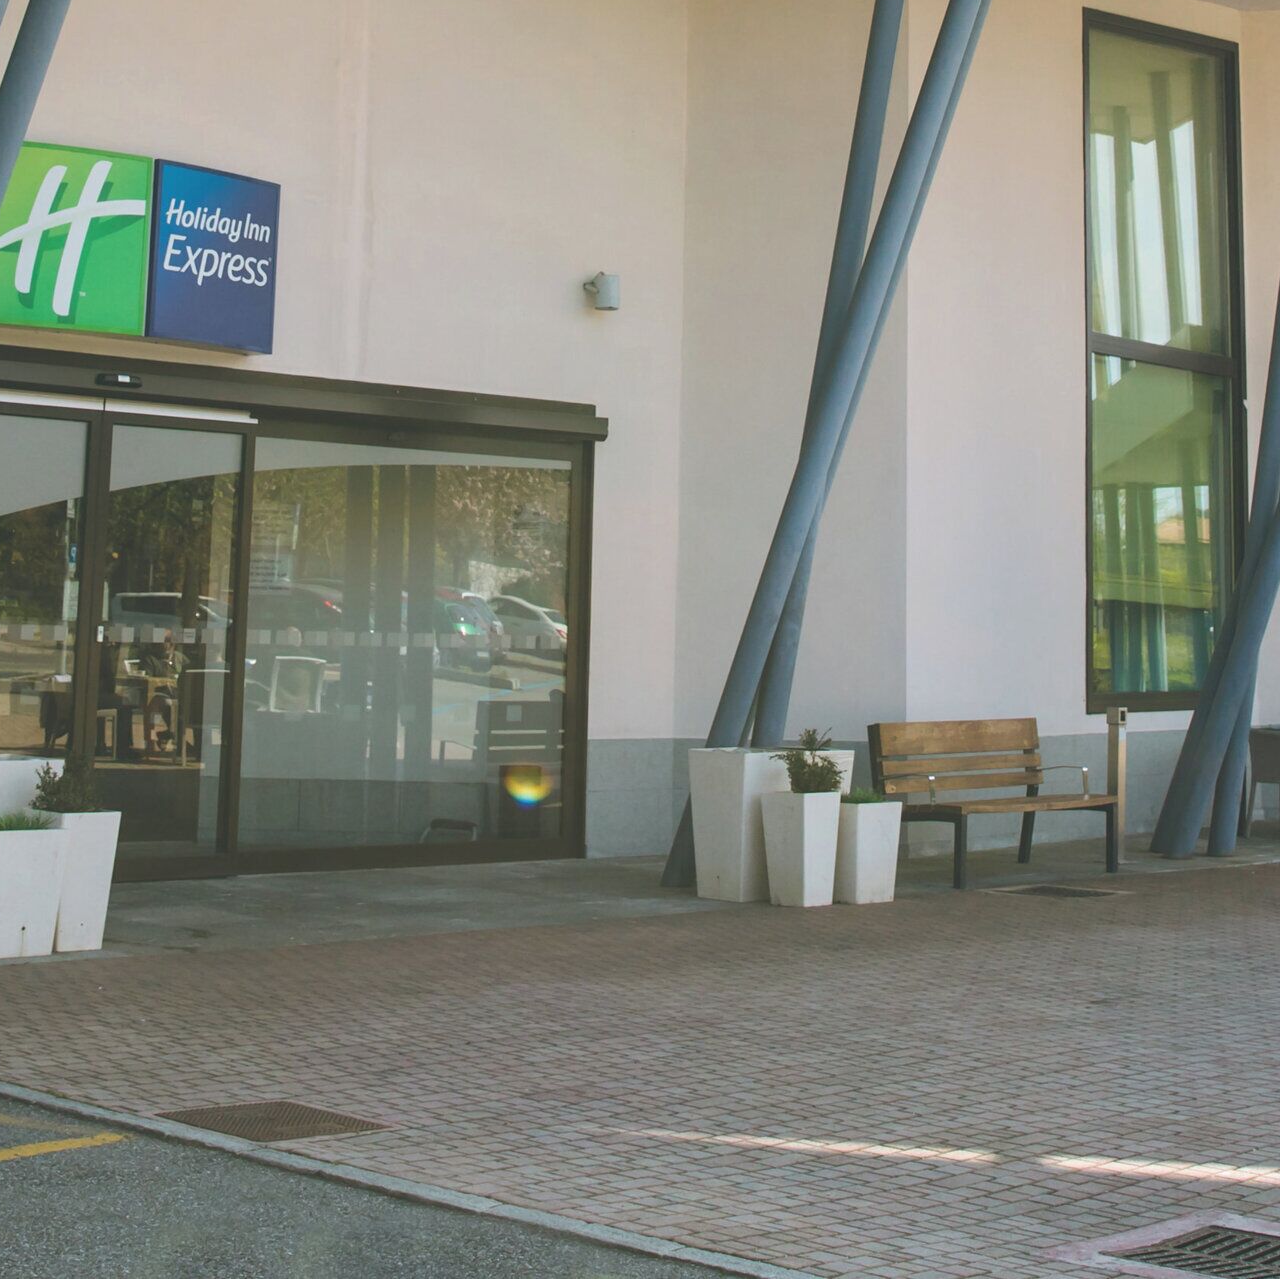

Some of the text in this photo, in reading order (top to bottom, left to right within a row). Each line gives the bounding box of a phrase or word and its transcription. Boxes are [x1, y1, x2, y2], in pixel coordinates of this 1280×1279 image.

[165, 198, 272, 244] Holiday Inn
[163, 233, 270, 288] Express
